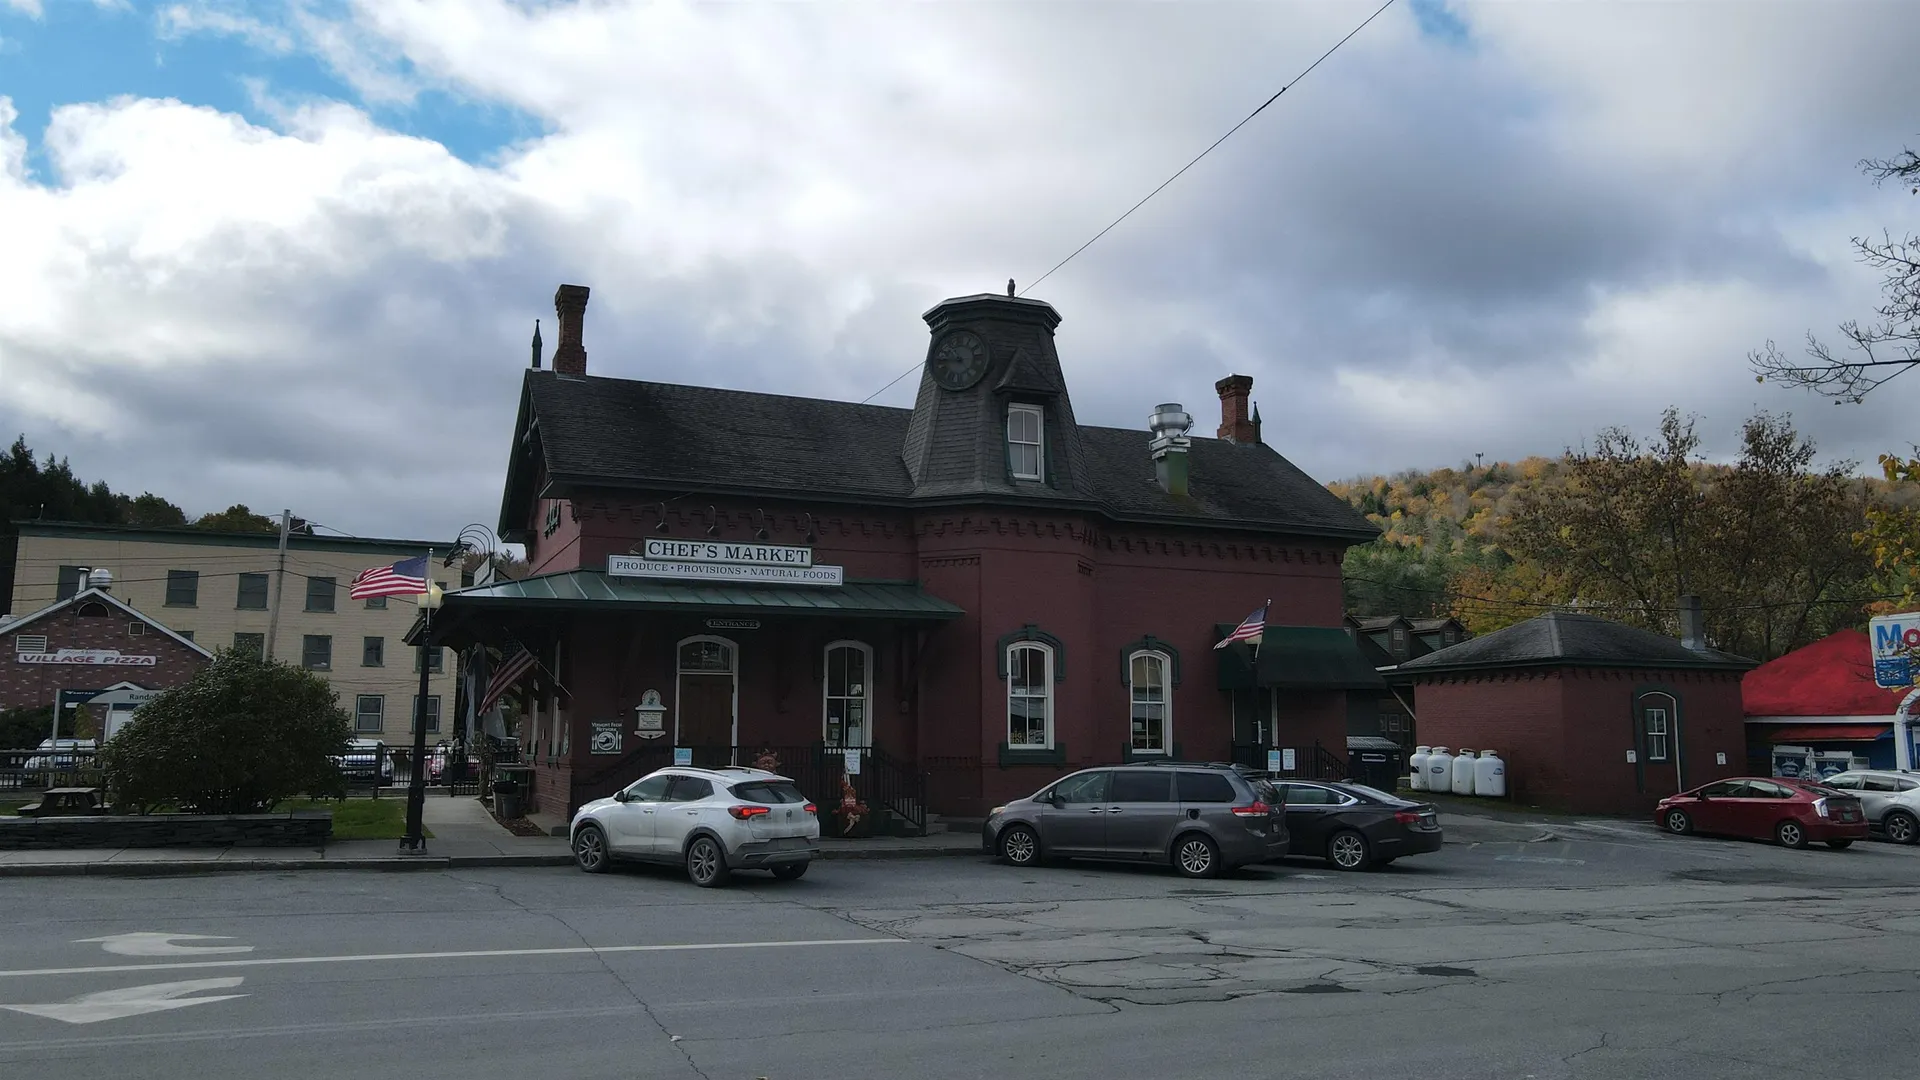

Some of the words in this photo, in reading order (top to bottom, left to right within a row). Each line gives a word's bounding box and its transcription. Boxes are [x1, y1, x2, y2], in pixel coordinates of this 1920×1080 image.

[647, 541, 718, 559] CHEF'S
[724, 546, 809, 563] MARKET
[615, 561, 669, 572] PRODUCE
[676, 565, 742, 575] PROVISIONS
[750, 568, 800, 578] NATURAL
[803, 570, 837, 580] FOODS
[23, 655, 95, 663] VILLAGE
[102, 656, 153, 664] PIZZA
